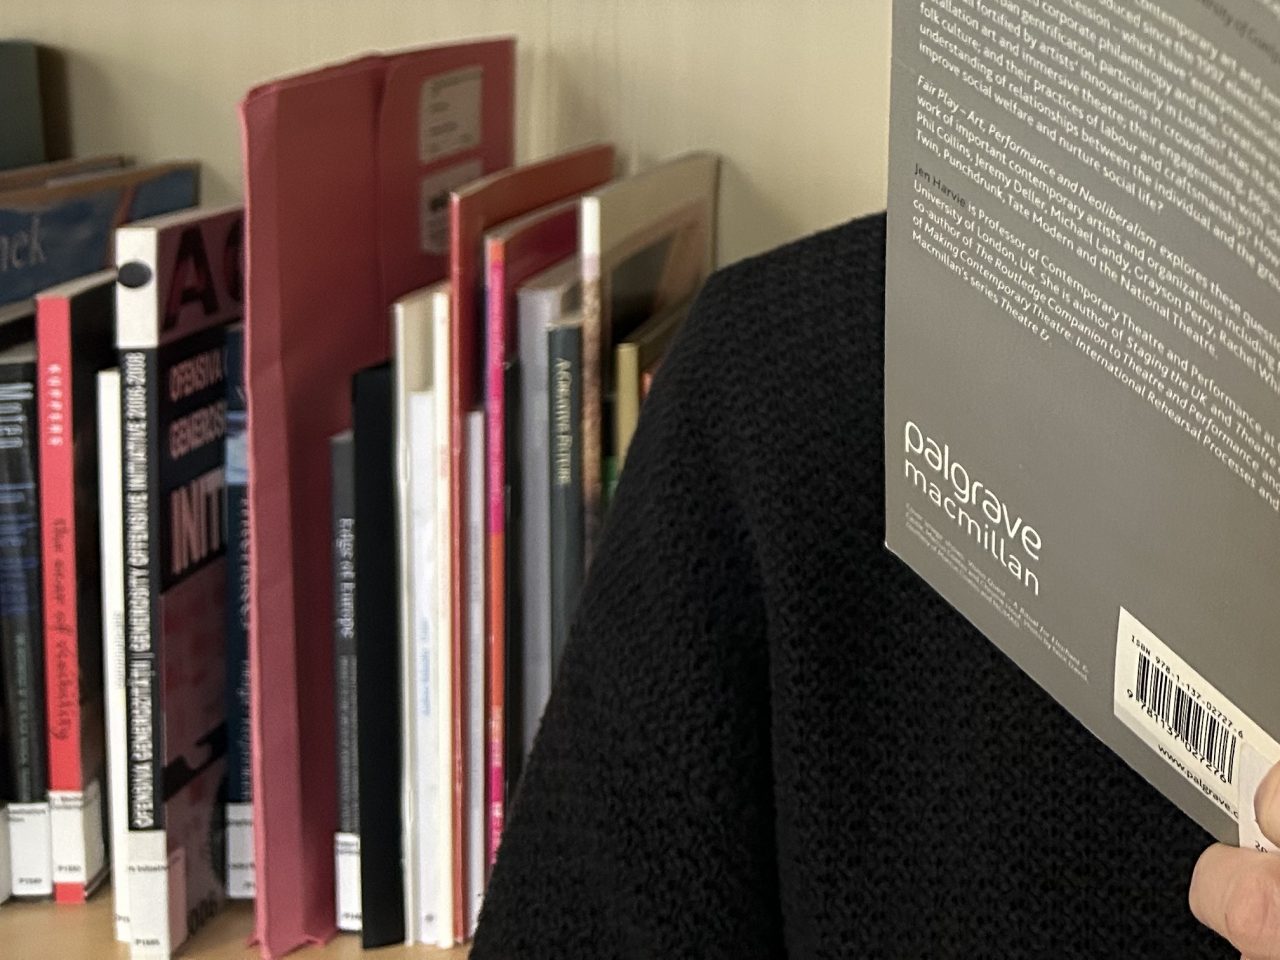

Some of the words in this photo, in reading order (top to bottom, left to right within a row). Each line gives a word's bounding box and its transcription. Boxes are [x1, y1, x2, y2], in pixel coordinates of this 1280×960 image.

[917, 75, 936, 94] Fair
[938, 88, 958, 112] Play
[967, 110, 985, 131] Art,
[988, 124, 1054, 175] Performance
[1057, 174, 1076, 192] and
[1079, 187, 1156, 247] Neoliberalism
[1159, 246, 1206, 286] explores
[1210, 280, 1240, 315] these
[914, 163, 929, 182] Jen
[932, 177, 965, 207] Harvie
[968, 204, 976, 217] is
[978, 209, 1025, 249] Professor
[1027, 248, 1038, 259] of
[1041, 255, 1119, 320] Contemporary
[1122, 313, 1164, 350] Theatre
[1167, 350, 1188, 371] and
[1191, 365, 1261, 430] Performance
[1263, 432, 1275, 447] at
[124, 421, 148, 491] INITIATIVE
[904, 420, 1043, 561] palgrave
[125, 492, 150, 566] OFFENSIVE
[904, 458, 1039, 596] macmillan
[336, 582, 355, 638] Europe
[1131, 635, 1150, 655] ISBN
[1158, 743, 1239, 817] www.palgrave.c
